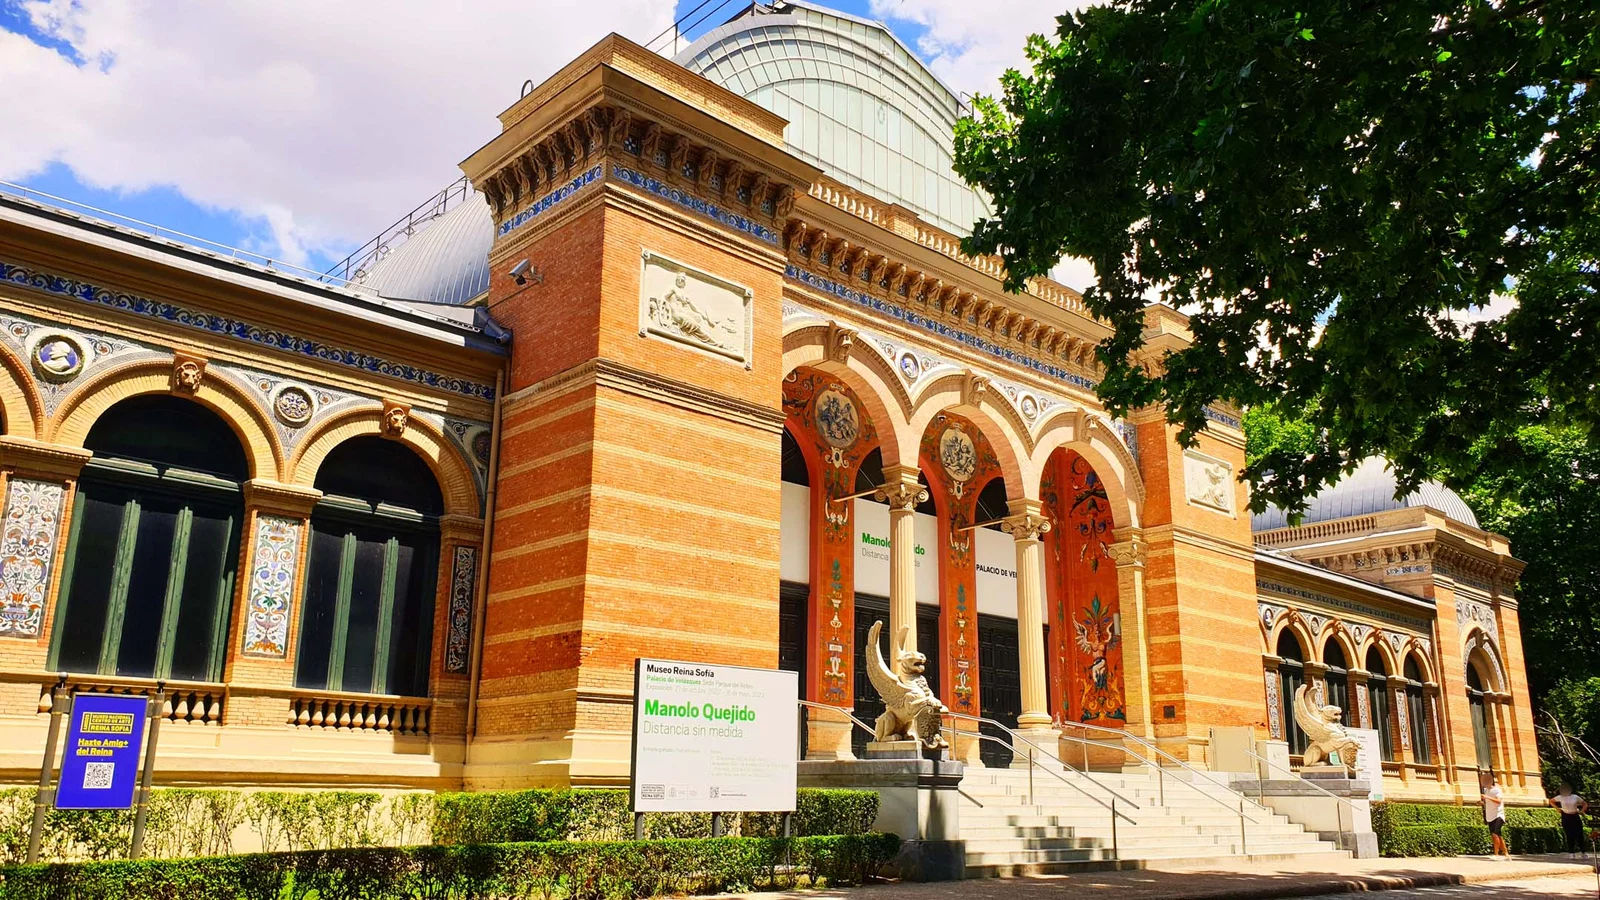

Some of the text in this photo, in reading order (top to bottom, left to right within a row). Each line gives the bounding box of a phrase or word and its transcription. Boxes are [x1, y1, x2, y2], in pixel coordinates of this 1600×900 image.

[862, 547, 889, 561] Distancia
[976, 564, 1000, 575] PALACIO
[1001, 569, 1008, 577] DE
[646, 664, 715, 678] Museo Reina Sofía
[646, 674, 667, 683] Palacio
[644, 699, 756, 724] Manolo Quejido
[643, 720, 743, 738] Distancia sin medida
[76, 747, 113, 756] del Reina
